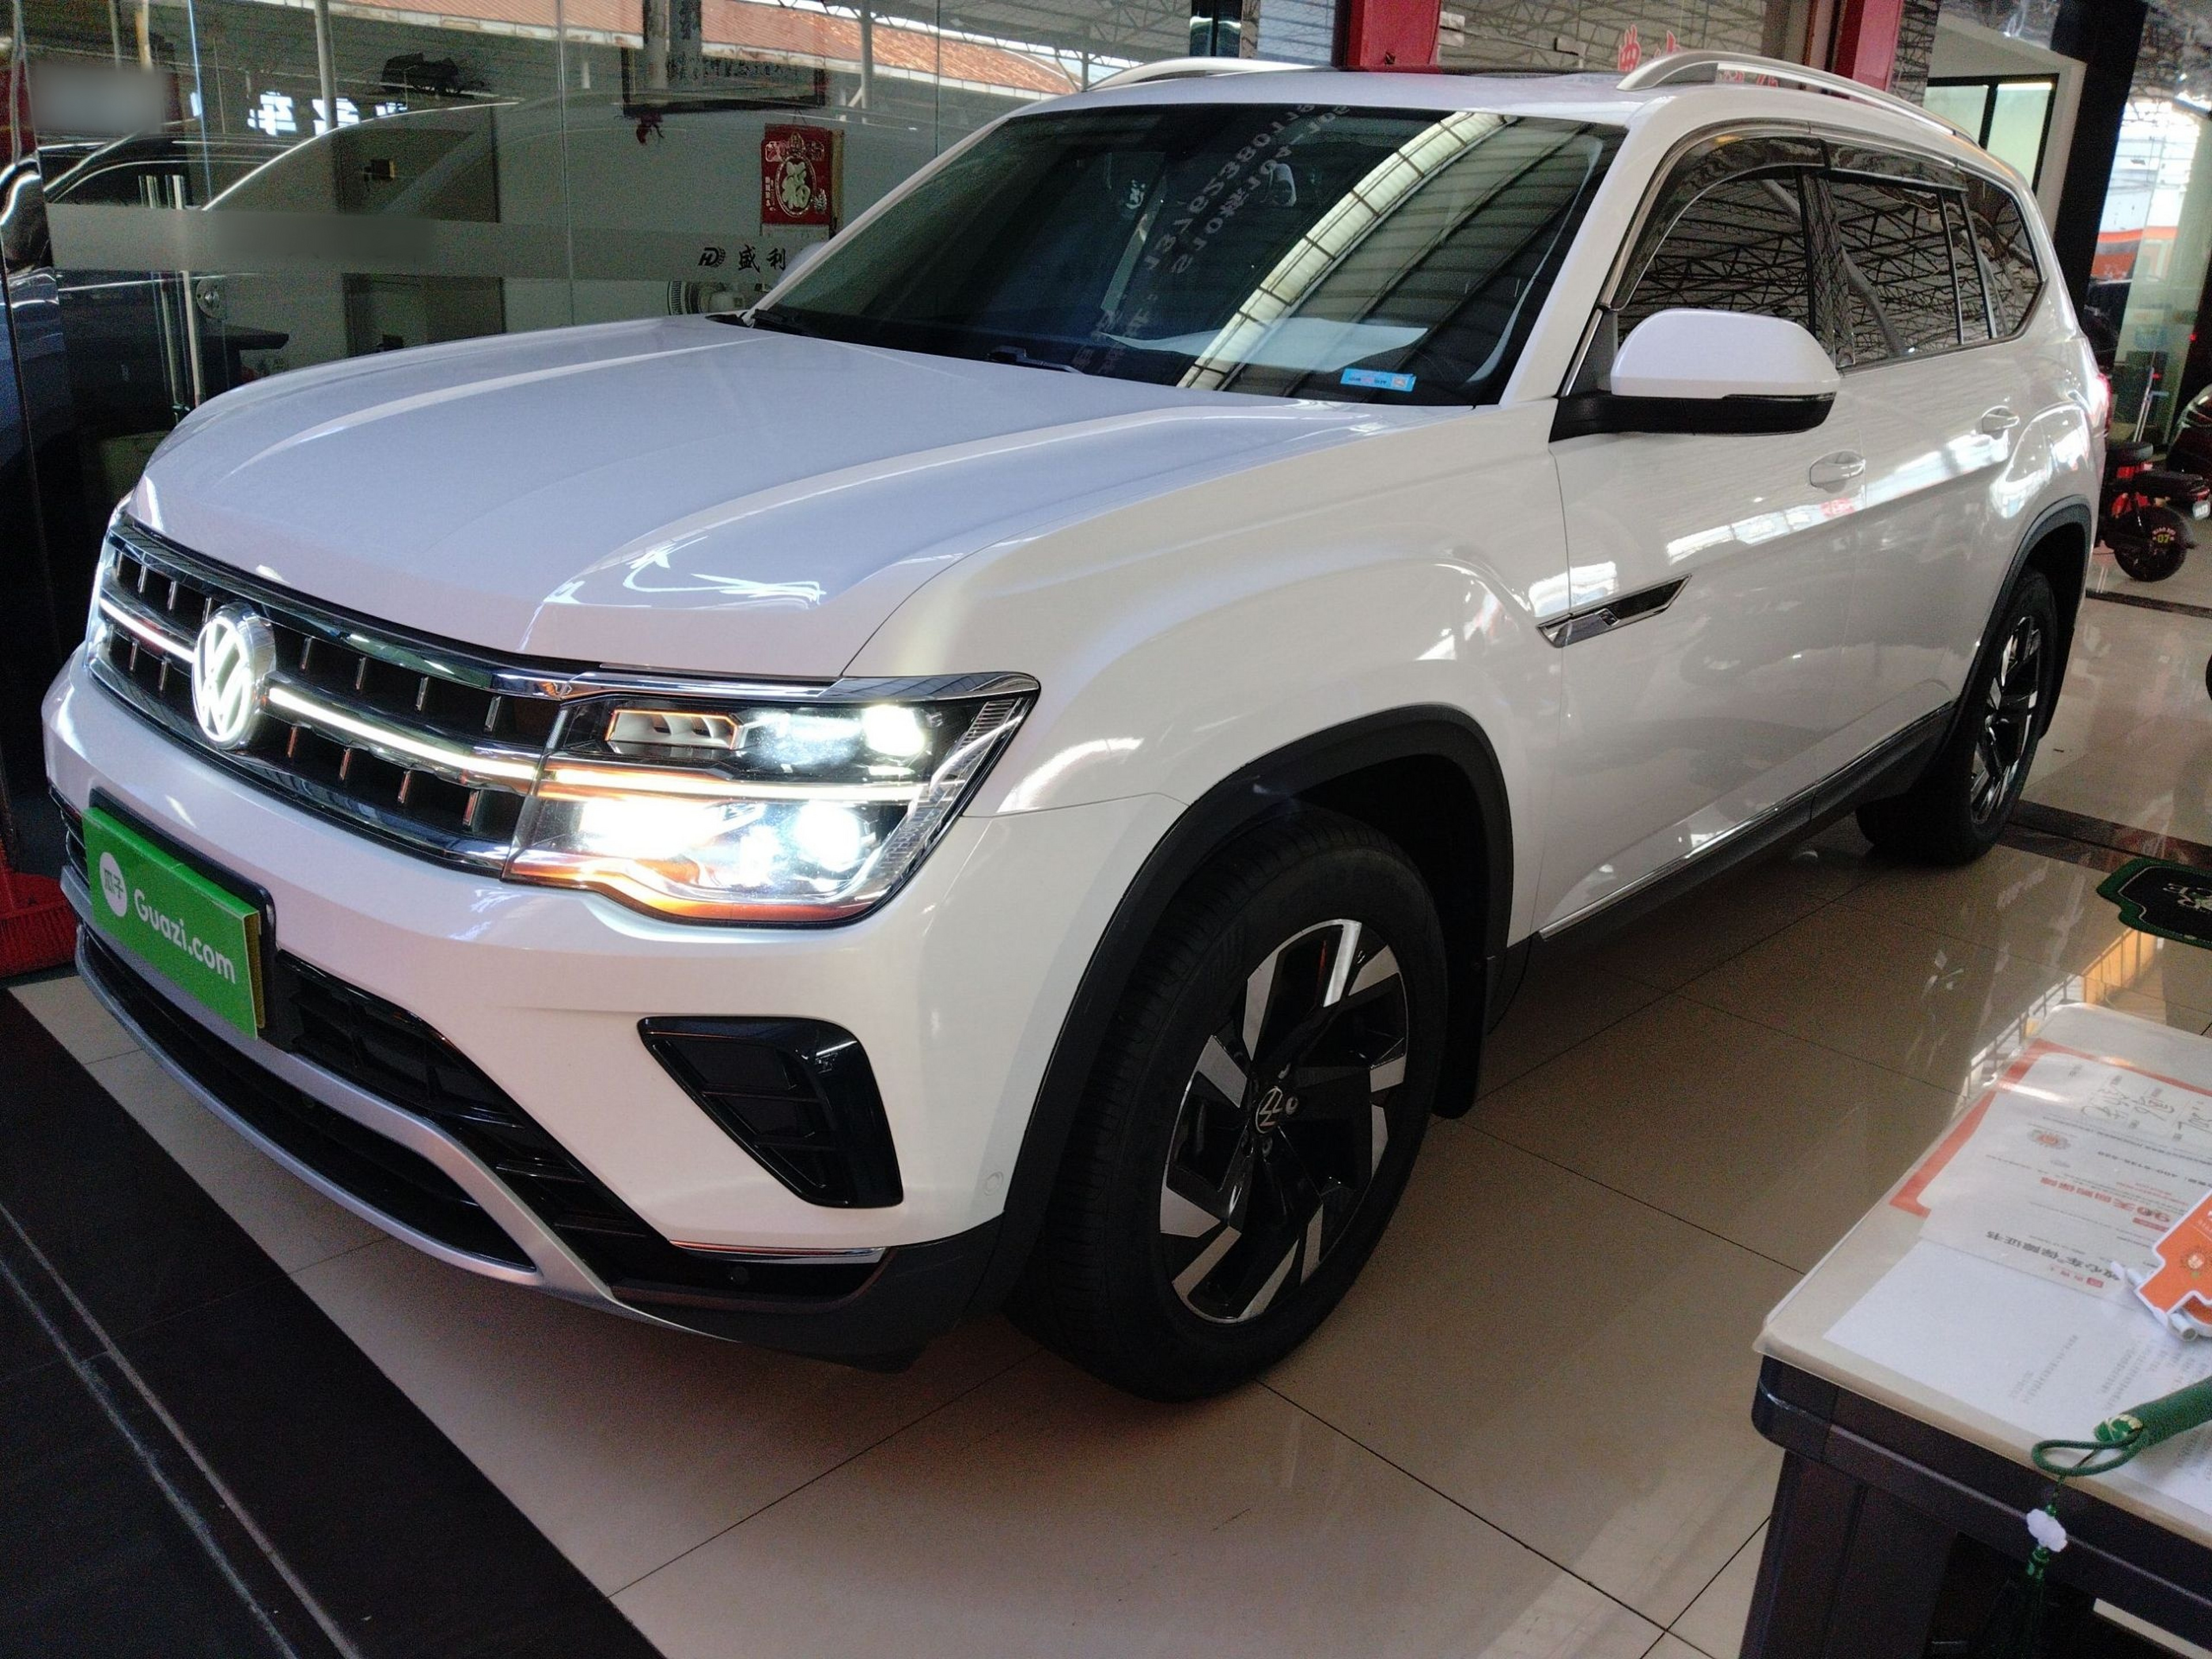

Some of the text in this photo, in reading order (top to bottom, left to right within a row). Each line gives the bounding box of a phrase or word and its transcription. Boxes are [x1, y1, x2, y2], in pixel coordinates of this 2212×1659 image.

[782, 161, 811, 209] 福
[103, 868, 124, 900] 瓜子
[134, 888, 236, 984] Guazi.com
